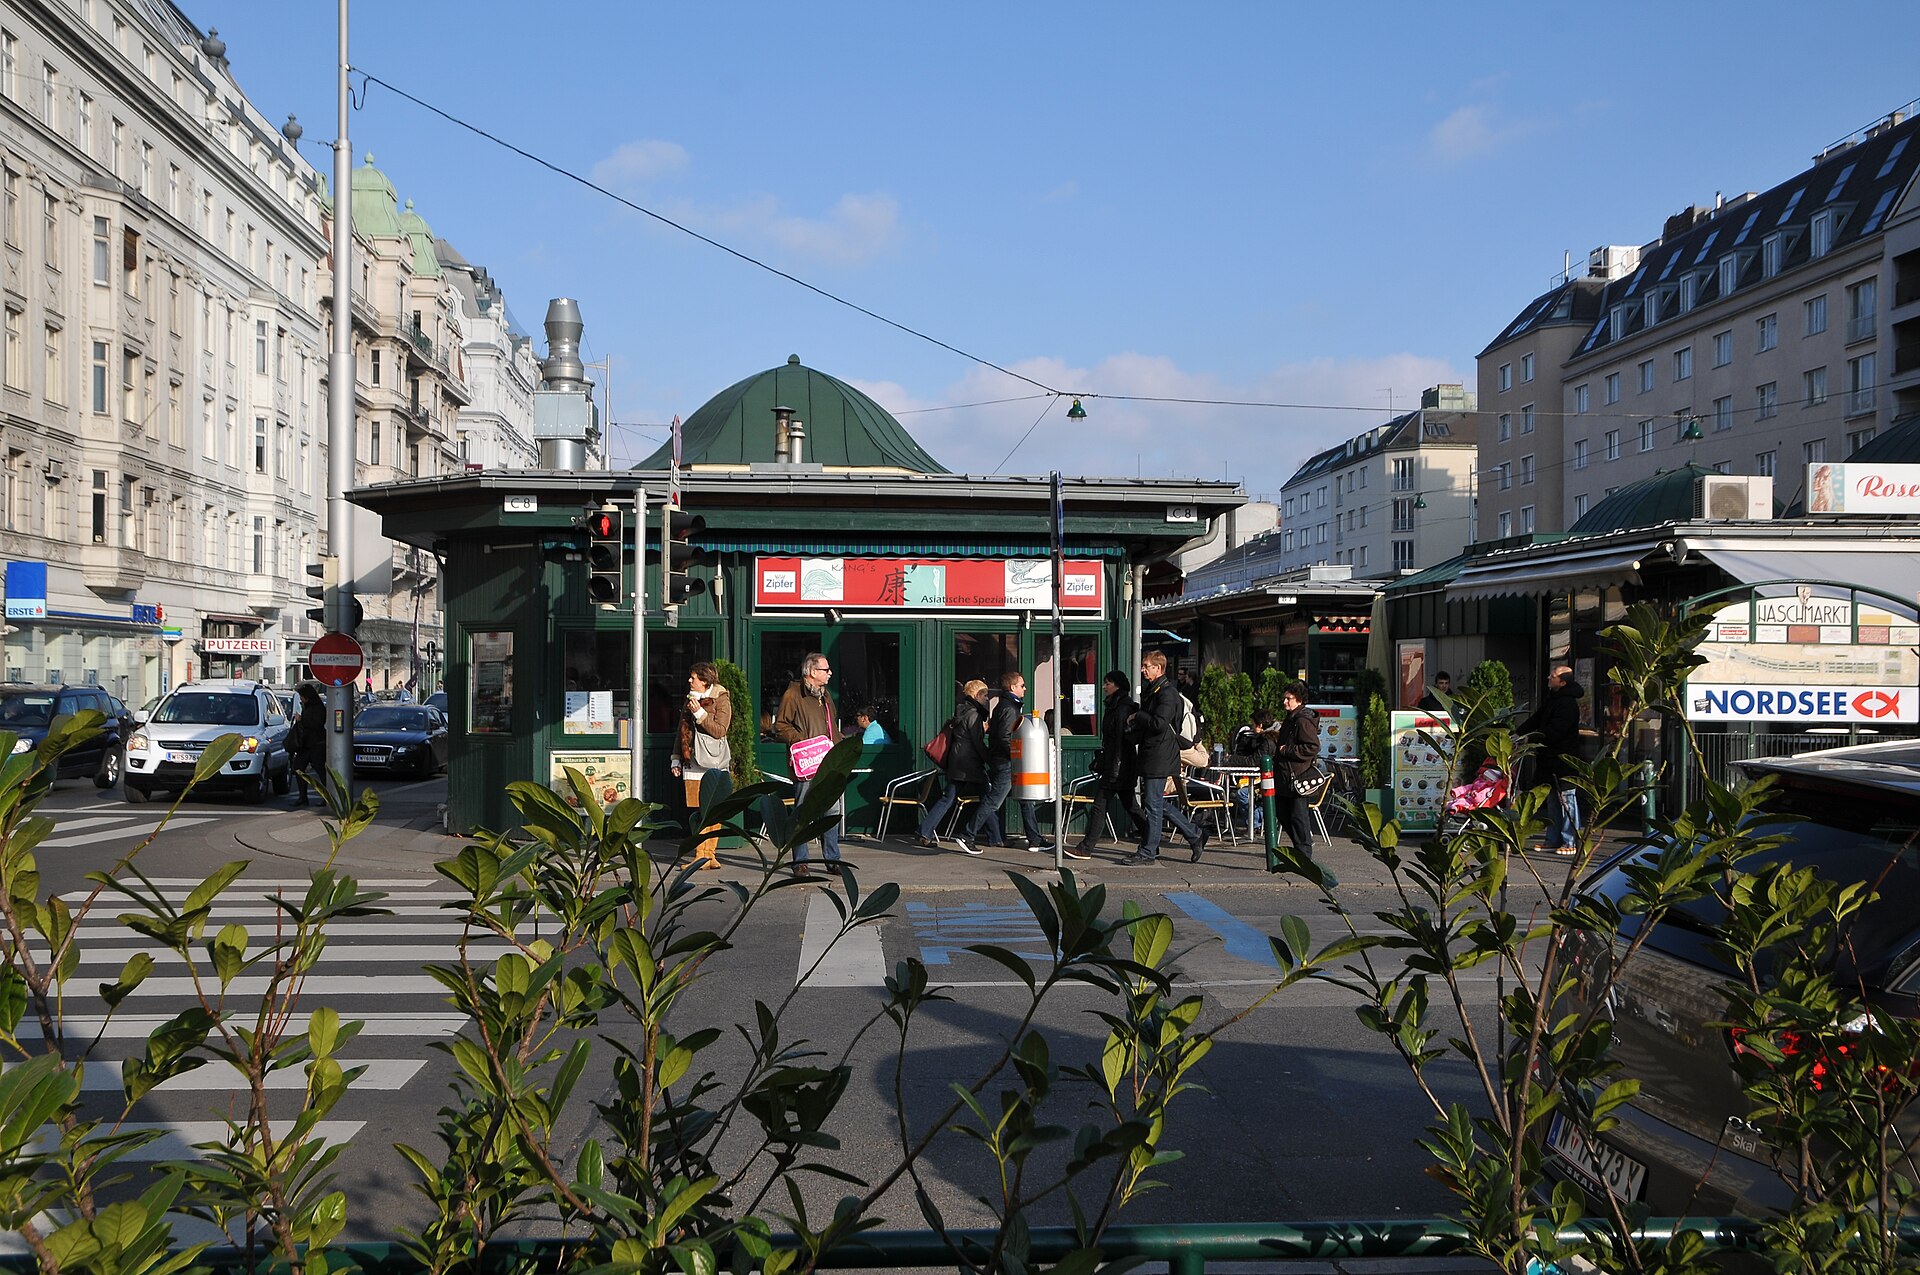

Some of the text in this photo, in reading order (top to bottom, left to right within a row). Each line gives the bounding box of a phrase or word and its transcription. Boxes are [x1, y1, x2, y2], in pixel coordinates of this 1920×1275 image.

[511, 498, 531, 509] C 8
[1172, 507, 1192, 519] C 8
[766, 579, 794, 589] Zipfer
[1066, 582, 1094, 592] Zipfer
[920, 595, 1035, 606] Asiatische Spezialitäten
[8, 607, 34, 616] ERSTE
[207, 640, 272, 650] PUTZEREI
[1705, 690, 1847, 715] NORDSEE
[1733, 1135, 1757, 1153] Skal
[1566, 1166, 1595, 1192] SKAL
